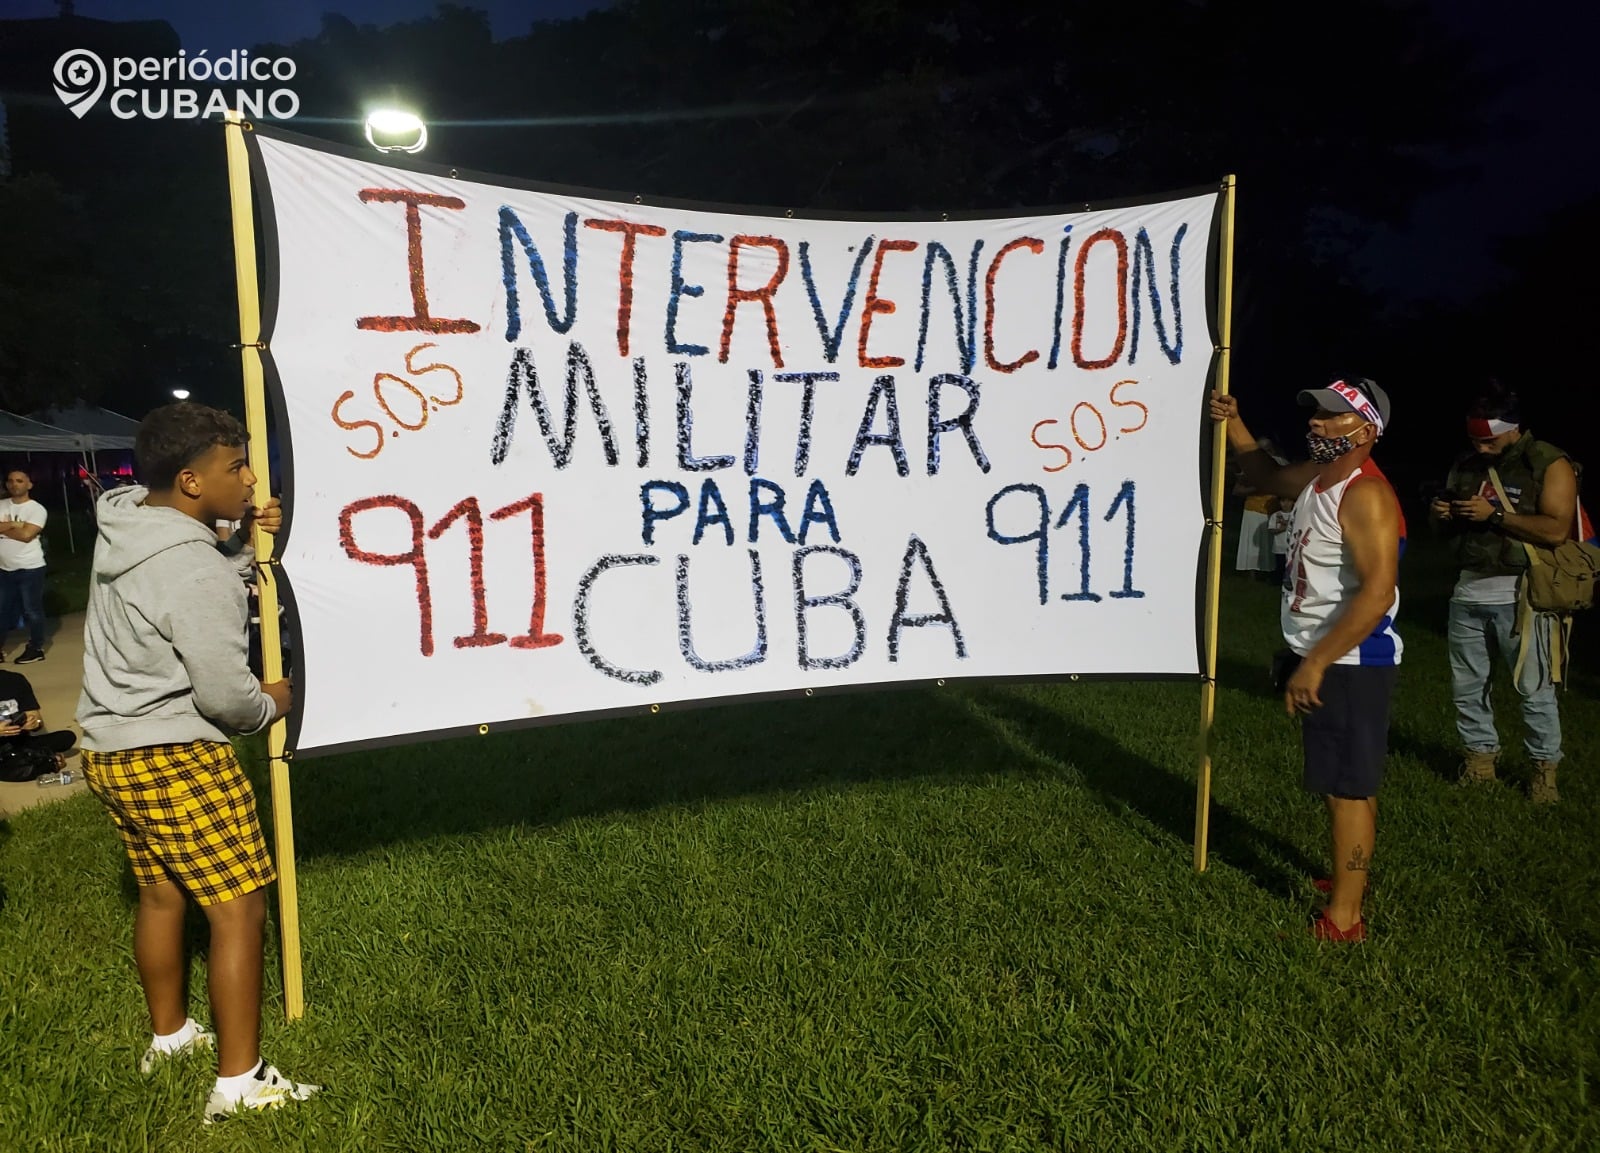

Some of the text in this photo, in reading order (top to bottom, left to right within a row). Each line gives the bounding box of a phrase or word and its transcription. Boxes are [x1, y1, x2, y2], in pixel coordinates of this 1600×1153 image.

[491, 339, 991, 477] MILITAR
[338, 491, 565, 658] 911
[639, 476, 842, 546] PARA
[986, 479, 1145, 605] 911
[572, 533, 969, 686] CUBA
